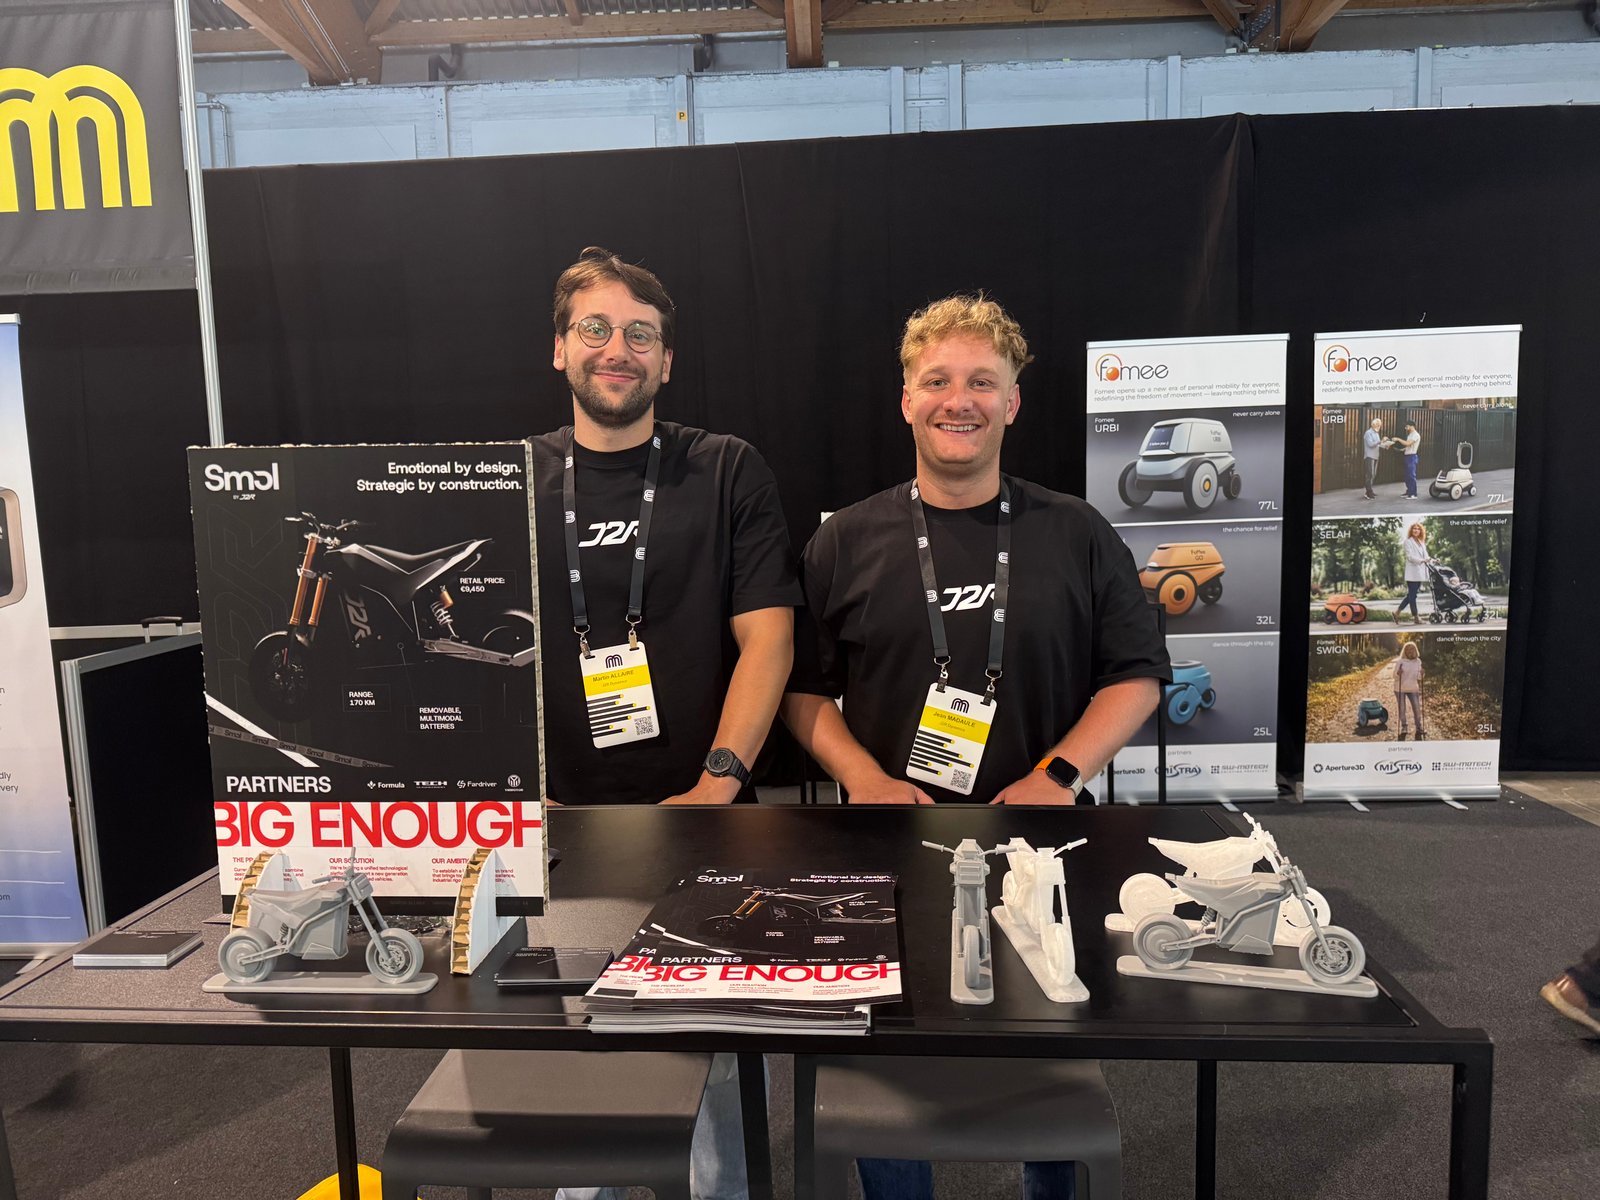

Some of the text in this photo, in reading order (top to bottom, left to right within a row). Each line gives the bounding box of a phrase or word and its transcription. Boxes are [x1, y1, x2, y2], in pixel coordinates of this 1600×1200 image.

[1323, 415, 1346, 424] URBI
[1095, 424, 1119, 432] URBI
[388, 462, 521, 476] Emotional by design.
[357, 478, 522, 494] Strategic by construction.
[1488, 494, 1508, 503] 77L
[1258, 500, 1278, 510] 77L
[1320, 530, 1351, 539] SELAH
[1483, 611, 1502, 619] 32L
[1256, 616, 1275, 624] 32L
[1316, 646, 1349, 654] SWIGN
[948, 716, 975, 727] MADAULE
[1254, 728, 1272, 736] 25L
[1477, 724, 1496, 733] 25L
[226, 776, 331, 793] PARTNERS
[214, 801, 542, 848] BIG ENOUGH
[642, 963, 900, 982] BIG ENOUGH
